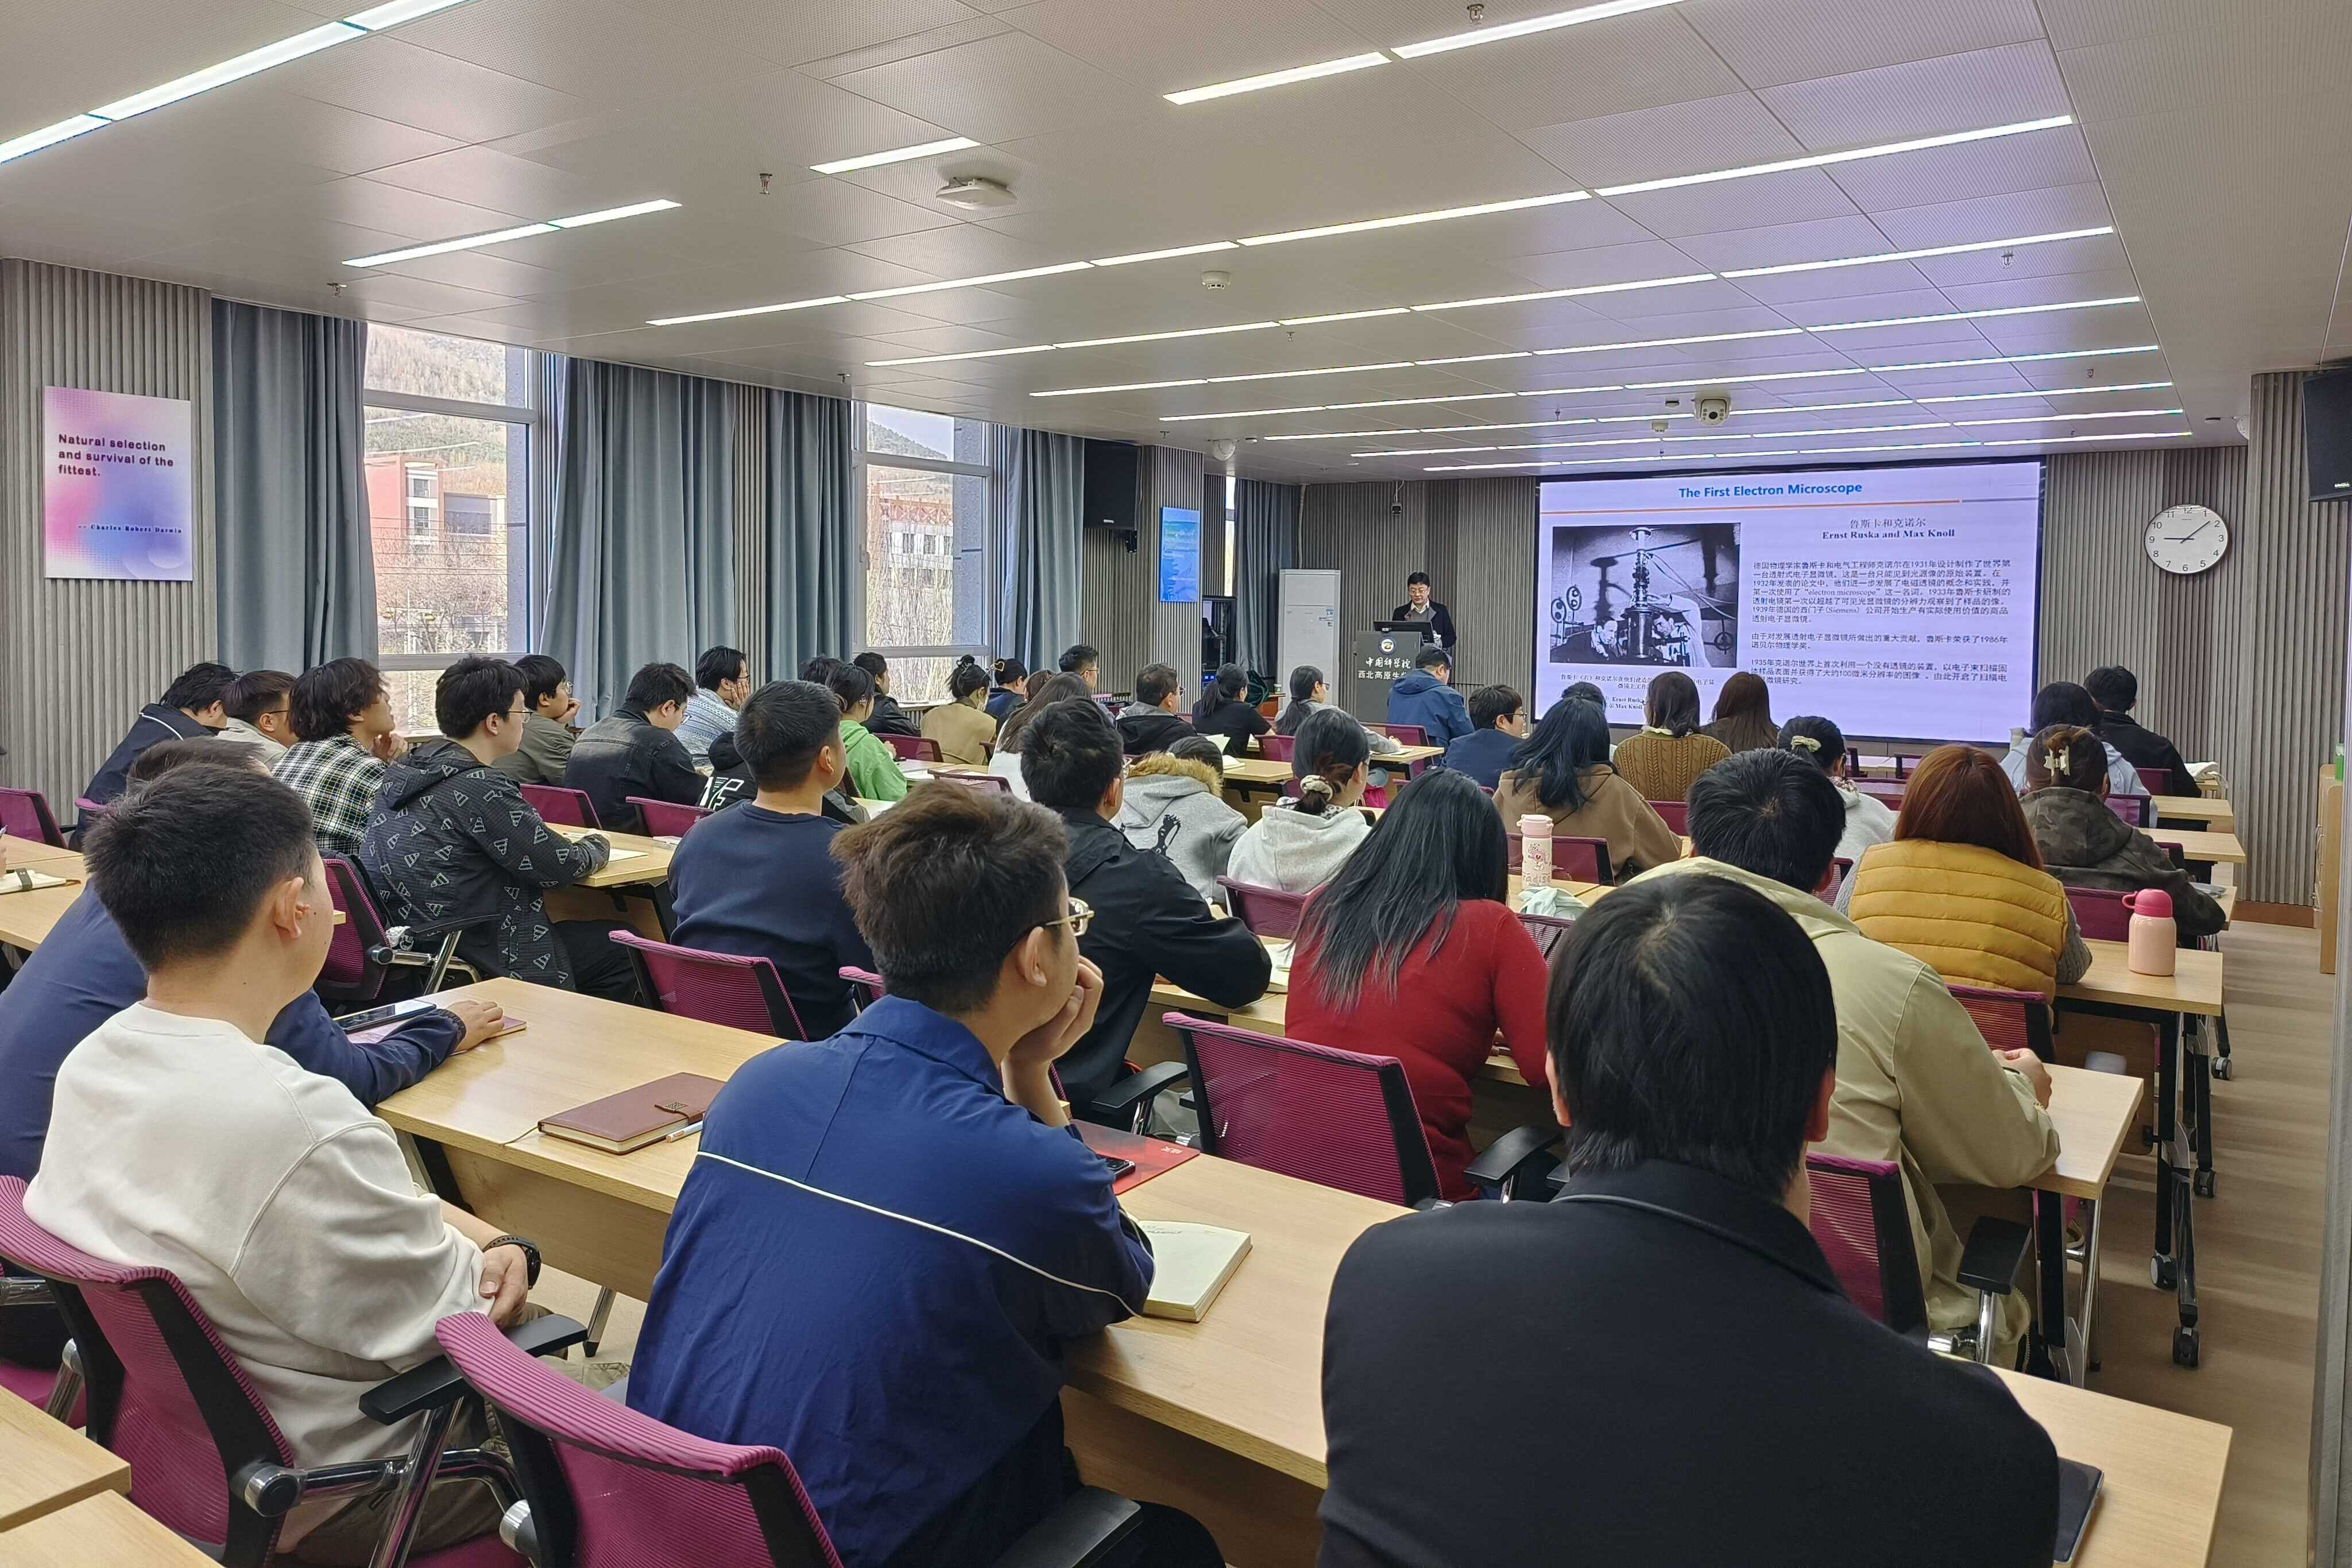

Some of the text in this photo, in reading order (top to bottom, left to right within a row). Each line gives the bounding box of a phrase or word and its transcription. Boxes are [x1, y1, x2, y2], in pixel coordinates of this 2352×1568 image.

[59, 433, 165, 451] Natural selection
[59, 451, 174, 467] and survival of the
[58, 464, 100, 477] fittest.
[1678, 483, 1862, 498] The First Electron Microscope
[1823, 529, 1955, 540] Ernst Ruska and Max Knoll
